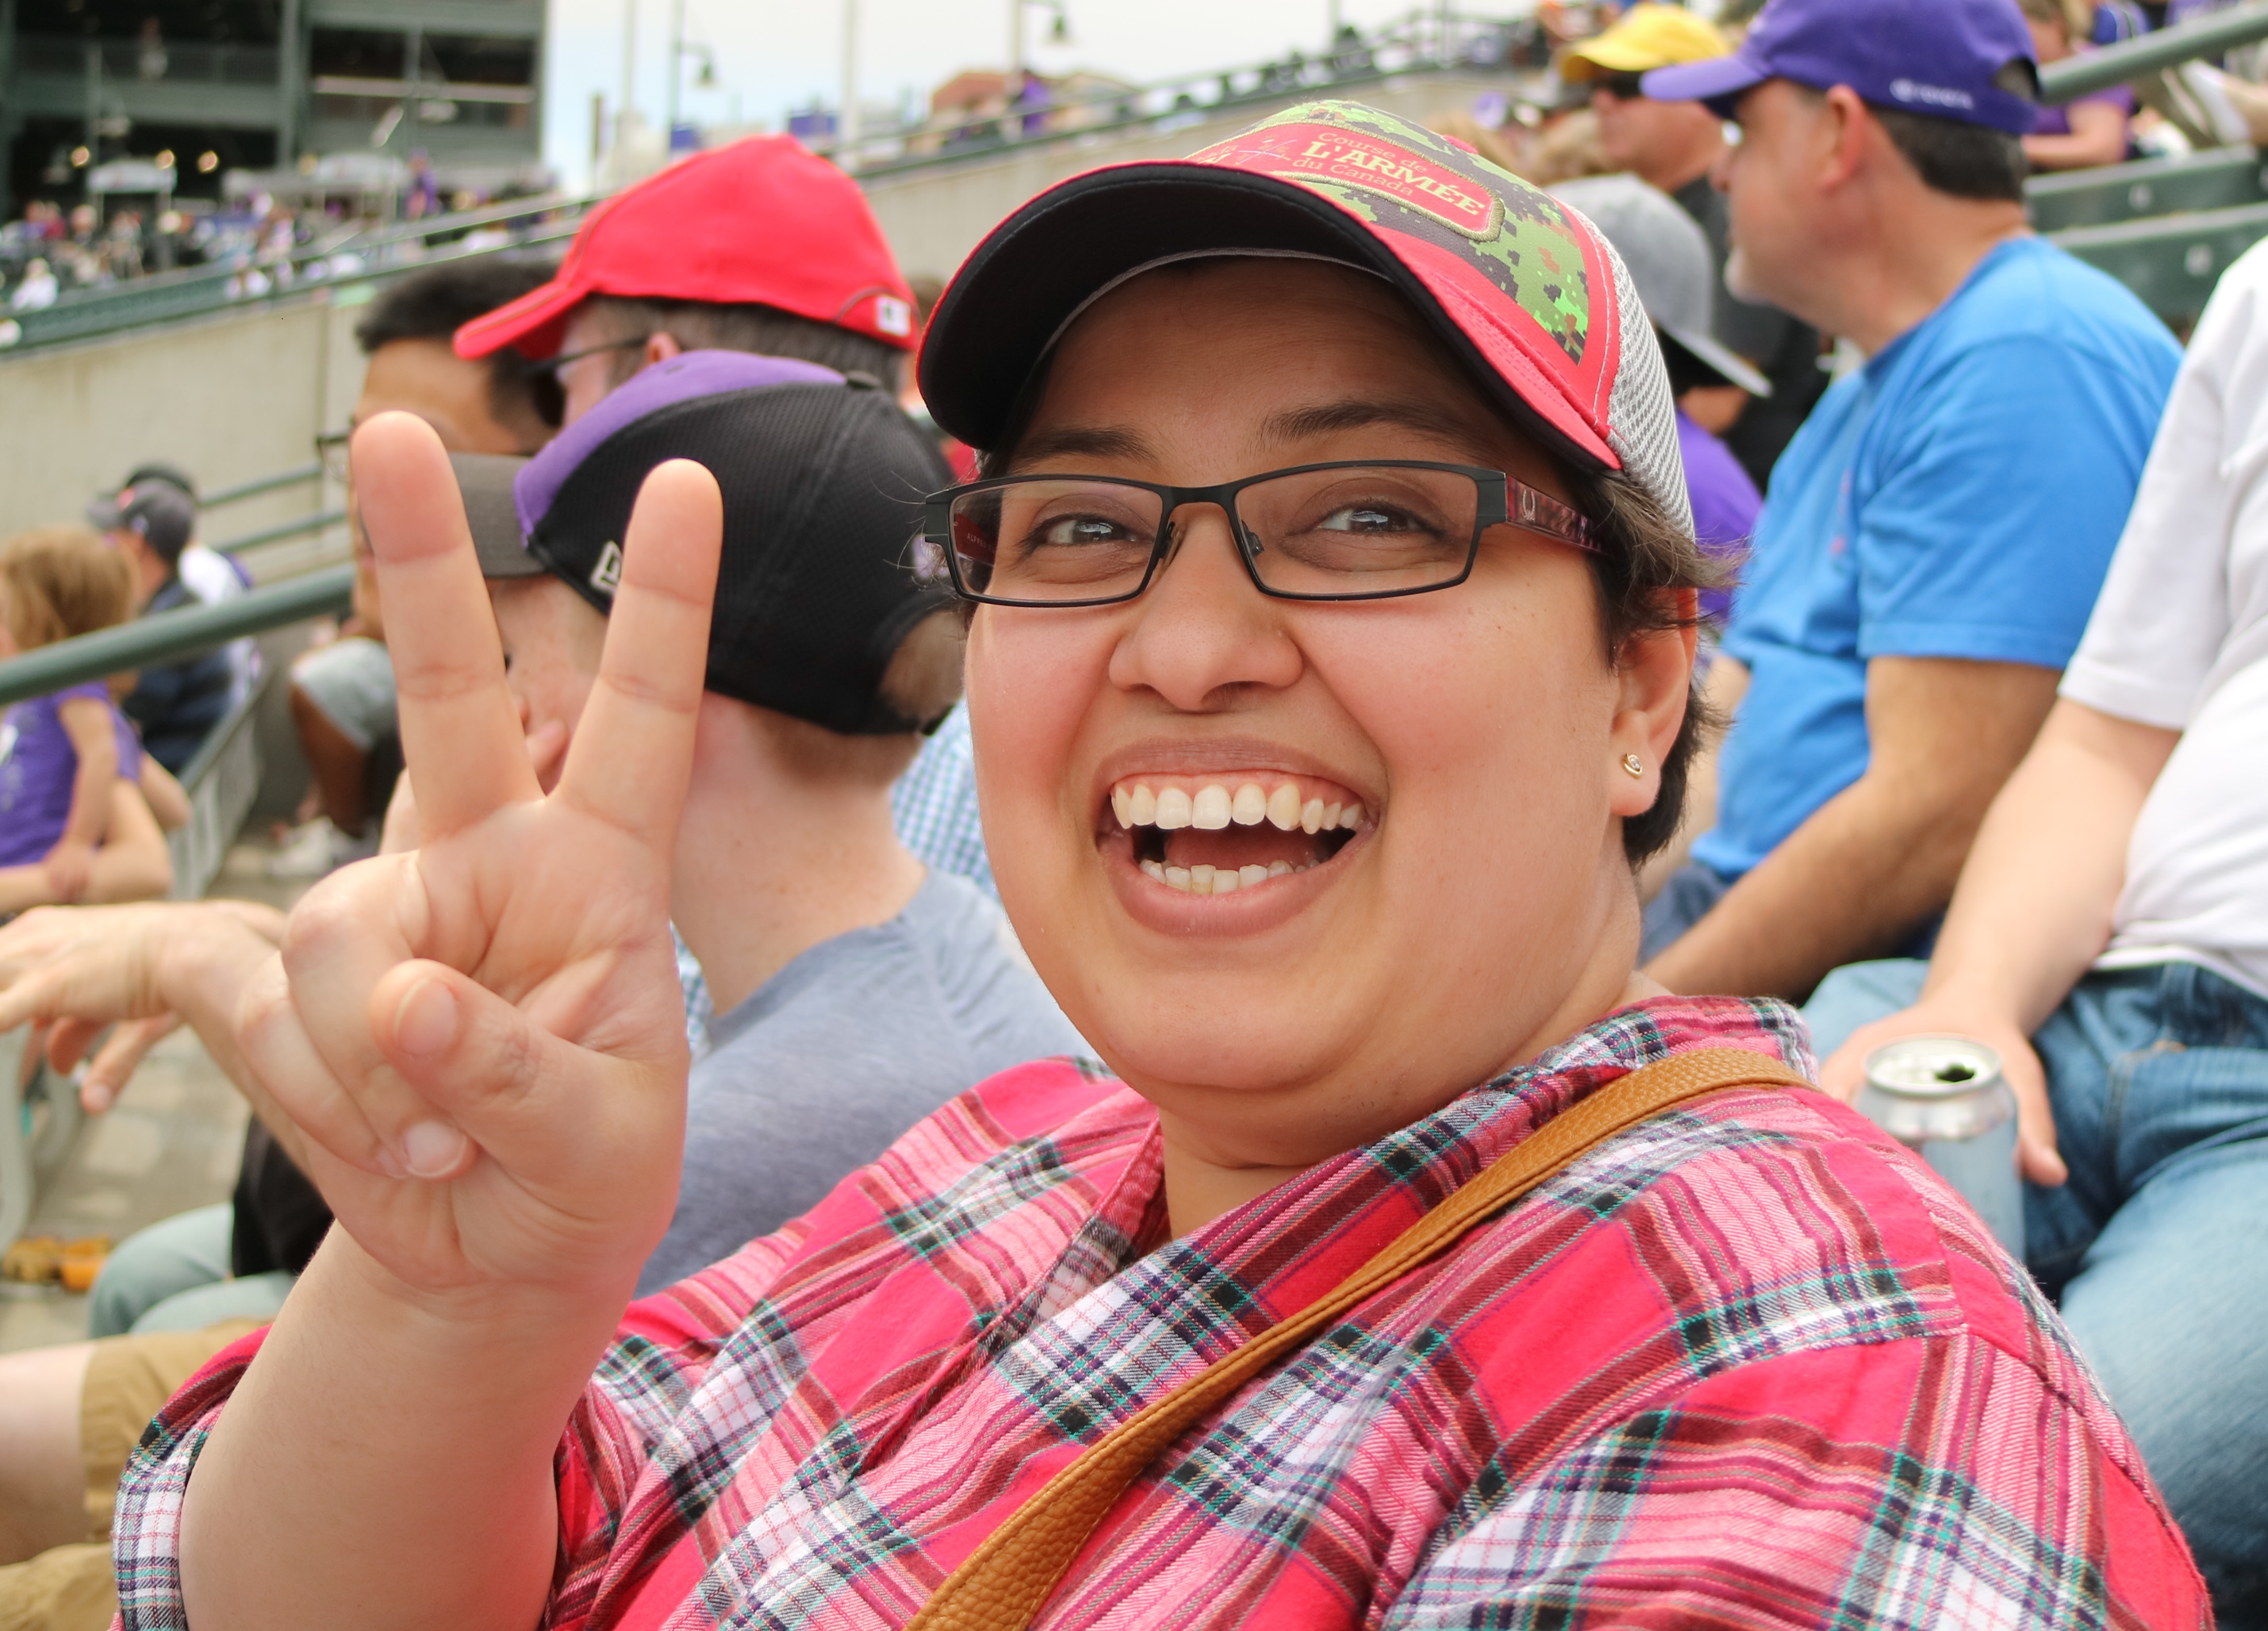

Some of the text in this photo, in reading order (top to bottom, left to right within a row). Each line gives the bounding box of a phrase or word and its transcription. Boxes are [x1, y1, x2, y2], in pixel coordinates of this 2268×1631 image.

[1318, 132, 1427, 173] Course de
[1292, 157, 1413, 196] du Canada
[1300, 141, 1485, 215] L'ARMÉE
